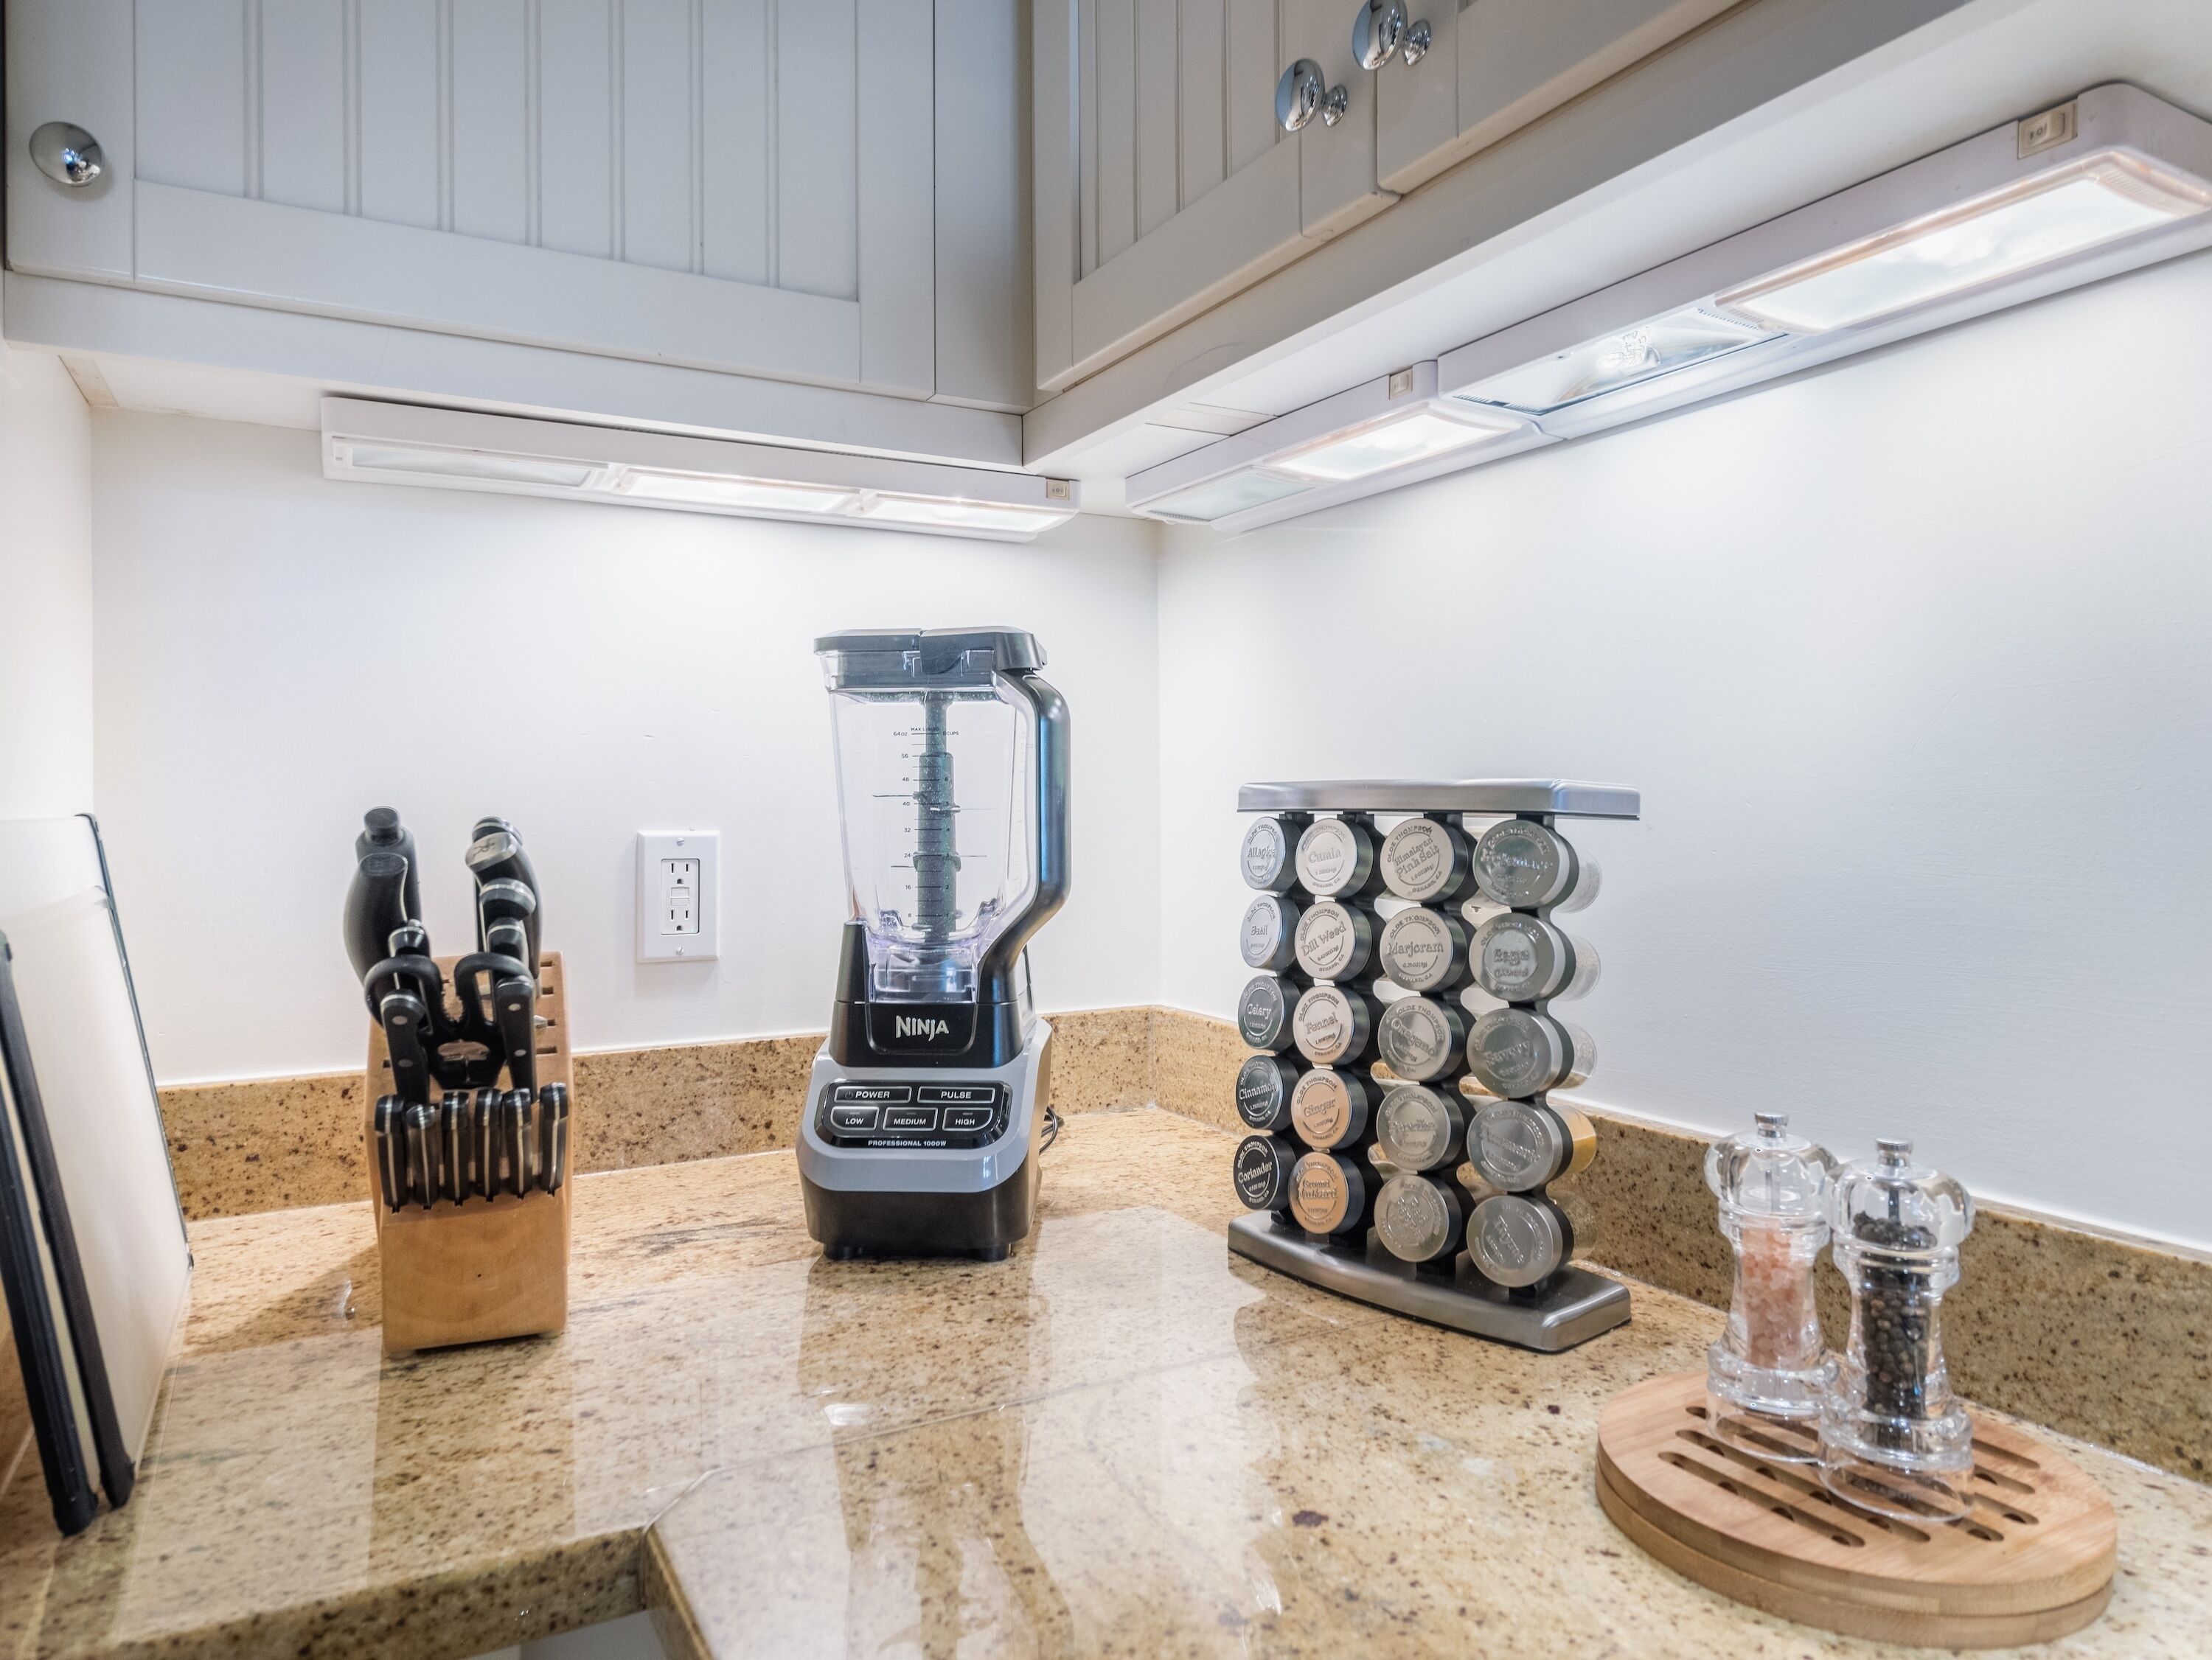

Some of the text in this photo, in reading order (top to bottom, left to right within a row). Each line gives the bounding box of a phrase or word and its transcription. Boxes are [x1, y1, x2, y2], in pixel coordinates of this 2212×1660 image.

[1248, 845, 1276, 859] Allspice
[1309, 848, 1341, 863] Cumin
[1394, 837, 1433, 866] Himalayan
[1395, 845, 1439, 878] Pink Salt
[1251, 924, 1268, 935] Basil
[1390, 920, 1404, 938] OLDE
[1301, 921, 1346, 957] Dill Weed
[1387, 941, 1444, 958] Marjoram
[1247, 1004, 1271, 1020] Celery
[1397, 1005, 1416, 1014] OLDE
[896, 1015, 949, 1042] NINJA
[1306, 1076, 1338, 1089] THOMPSON
[941, 1091, 972, 1099] PULSE
[1239, 1084, 1277, 1100] Cinnamon
[1304, 1098, 1335, 1117] Ginger
[1239, 1162, 1272, 1184] Coriander
[1298, 1186, 1337, 1200] Mustard
